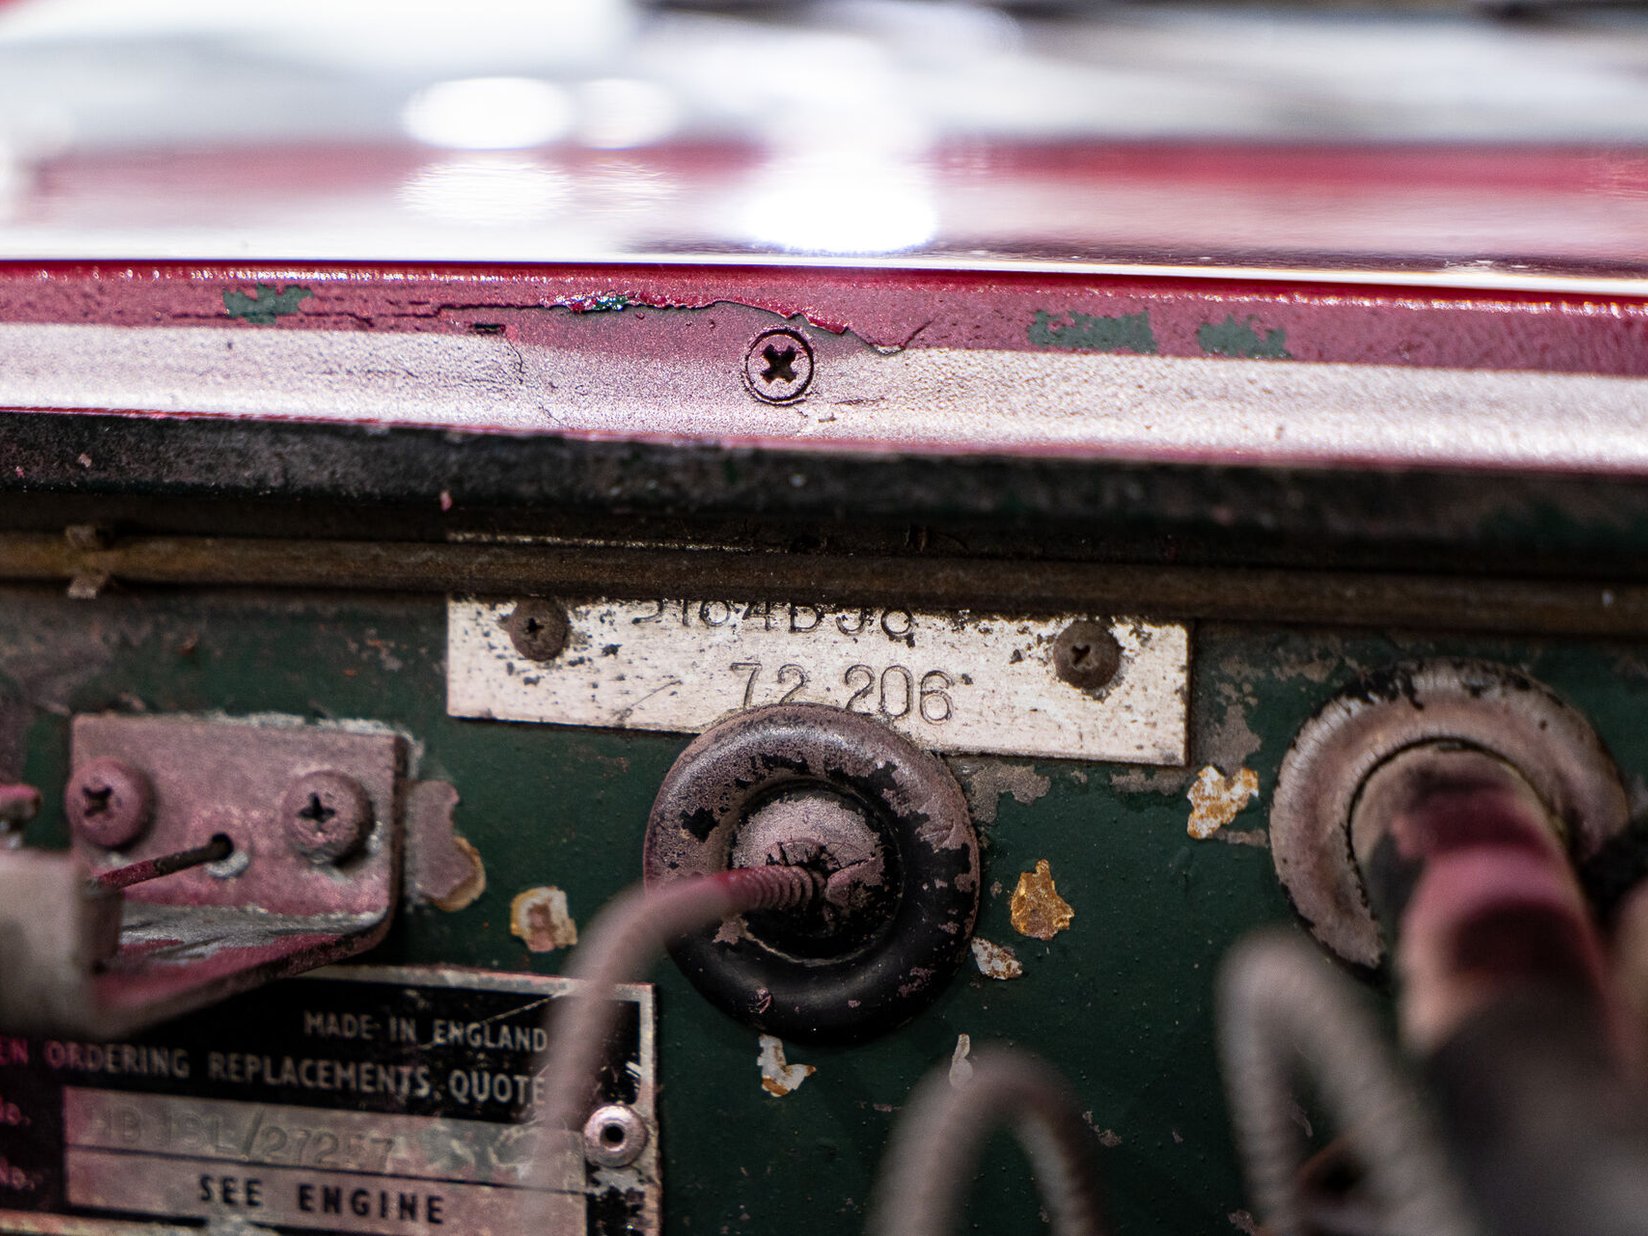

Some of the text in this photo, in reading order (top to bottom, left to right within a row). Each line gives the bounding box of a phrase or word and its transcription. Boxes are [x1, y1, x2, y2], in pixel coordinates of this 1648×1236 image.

[730, 662, 954, 724] 72 206
[304, 1010, 548, 1051] MADE IN ENGLAND
[45, 1040, 191, 1077] ORDERING
[450, 1071, 548, 1105] QUOTE
[200, 1174, 263, 1207] SEE
[297, 1183, 444, 1225] ENGINE
